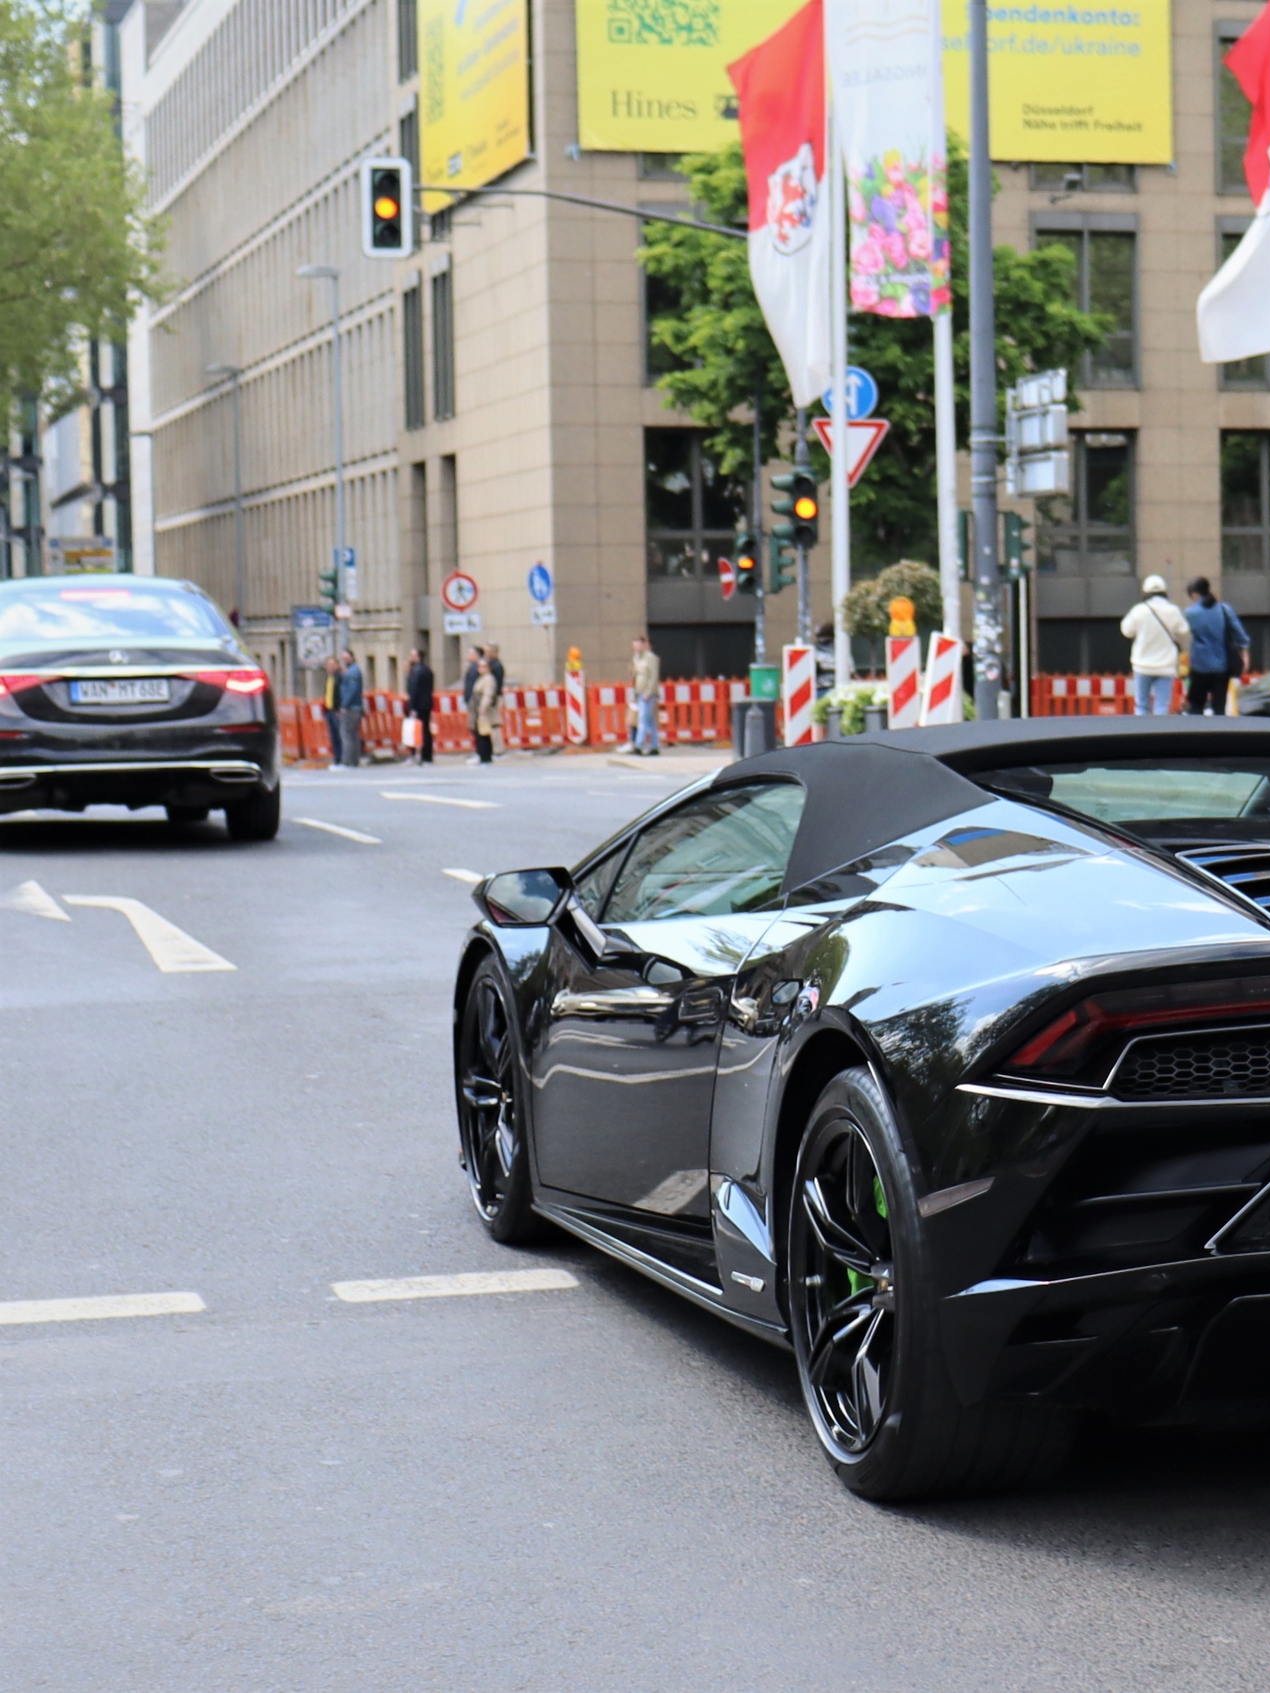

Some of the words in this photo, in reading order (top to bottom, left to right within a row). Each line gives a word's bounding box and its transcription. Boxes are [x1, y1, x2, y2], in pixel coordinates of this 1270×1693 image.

[610, 90, 697, 120] Hines
[1022, 103, 1093, 115] Düsseldorf
[1022, 118, 1056, 130] Nähe
[1060, 119, 1089, 131] trifft
[1093, 119, 1142, 132] Freiheit
